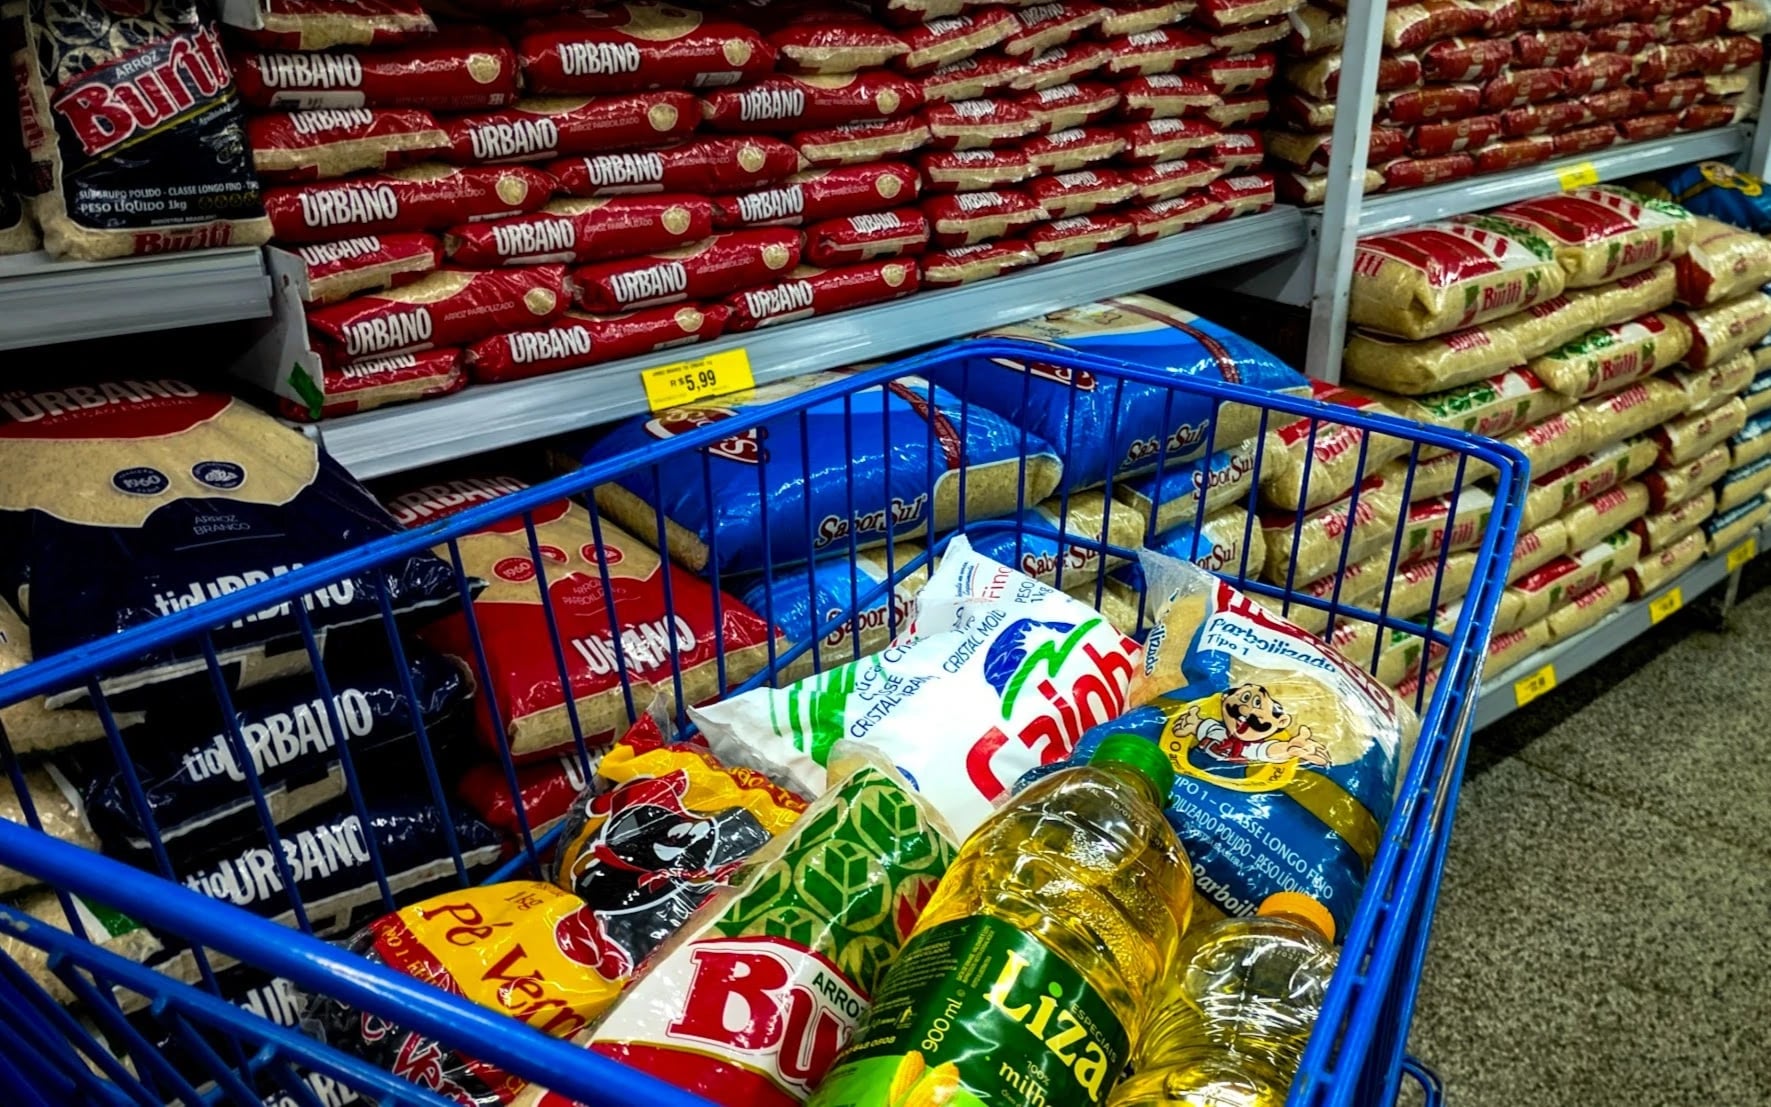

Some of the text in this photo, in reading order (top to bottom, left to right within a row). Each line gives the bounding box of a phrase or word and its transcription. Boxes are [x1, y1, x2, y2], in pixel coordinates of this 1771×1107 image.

[115, 51, 160, 80] ARROZ
[257, 53, 363, 89] URBANO
[557, 41, 641, 76] URBANO
[289, 108, 374, 135] URBANO
[738, 88, 805, 122] URBANO
[469, 117, 559, 158] URBANO
[583, 152, 664, 186] URBANO
[80, 200, 187, 215] PESO LÍQUIDO 1kg
[129, 187, 161, 198] POLIDO
[168, 186, 197, 197] CLASSE
[199, 184, 225, 196] LONGO
[299, 185, 399, 228] URBANO
[737, 184, 804, 222] URBANO
[492, 217, 576, 256] URBANO
[848, 212, 901, 235] URBANO
[610, 262, 688, 303] URBANO
[744, 280, 814, 319] URBANO
[342, 307, 433, 356] URBANO
[508, 325, 592, 363] URBANO
[684, 369, 717, 392] 5,99
[122, 474, 163, 489] 1960
[193, 522, 251, 536] BRANCO
[1015, 580, 1036, 604] PESO
[1031, 585, 1054, 603] 1kg
[942, 636, 985, 675] CRISTAL
[1206, 632, 1238, 650] Tipo
[1209, 617, 1337, 674] Parboilizado
[849, 692, 903, 739] CRISTAL
[1200, 790, 1209, 801] 1
[1218, 802, 1264, 839] CLASSE
[1262, 831, 1308, 874] LONGO
[1305, 868, 1334, 900] FINO
[1216, 823, 1252, 857] POLIDO
[1254, 853, 1281, 880] PESO
[505, 890, 543, 911] 1kg
[1193, 863, 1259, 918] Parboili
[422, 902, 513, 947] Pé
[812, 972, 862, 1021] ARRO
[921, 997, 964, 1053] 900 ml
[982, 948, 1110, 1102] Liza
[1069, 1002, 1118, 1064] ESPECIAIS
[999, 1061, 1046, 1107] milh
